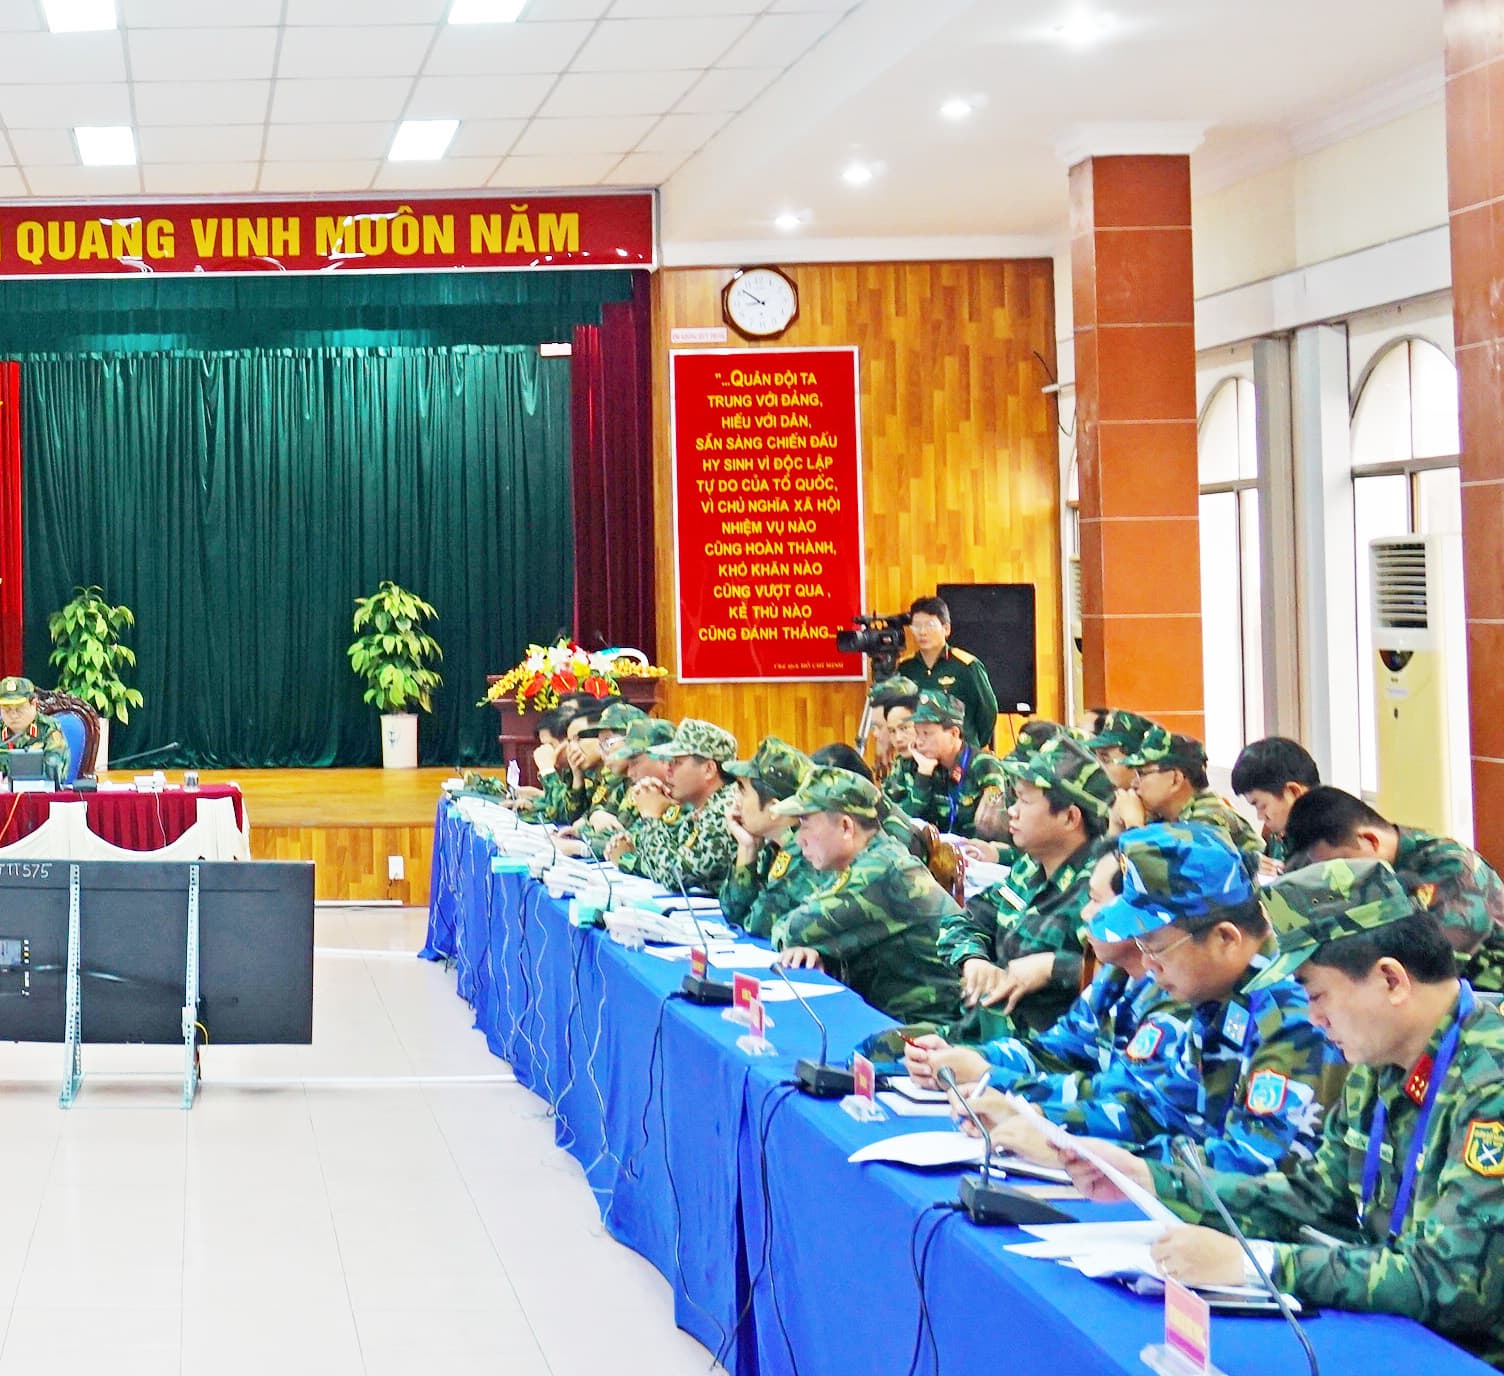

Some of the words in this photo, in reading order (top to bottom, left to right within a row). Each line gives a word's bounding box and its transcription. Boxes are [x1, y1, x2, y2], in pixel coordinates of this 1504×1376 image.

[16, 218, 175, 266] QUANG
[190, 217, 301, 259] VINH
[315, 205, 455, 257] MUÔN
[470, 204, 580, 254] NĂM
[773, 369, 798, 389] ĐỘI
[799, 371, 818, 386] TA
[706, 394, 753, 409] TRUNG
[755, 390, 779, 408] VỚI
[780, 389, 824, 408] ĐẢNG,
[721, 411, 752, 430] HIẾU
[754, 411, 777, 429] VỚI
[725, 434, 763, 451] SÀNG
[766, 431, 807, 450] CHIẾN
[809, 431, 838, 449] ĐẤU
[702, 458, 721, 472] HY
[723, 457, 754, 472] SINH
[756, 454, 770, 471] VÌ
[773, 454, 804, 472] ĐỘC
[806, 453, 834, 473] LẬP
[695, 478, 715, 496] TỰ
[717, 478, 739, 493] DO
[741, 474, 770, 493] CỦA
[771, 471, 792, 492] TỔ
[700, 497, 715, 514] VÌ
[717, 495, 746, 514] CHỦ
[747, 496, 790, 513] NGHĨA
[793, 496, 814, 513] XÃ
[816, 495, 841, 515] HỘI
[721, 517, 763, 537] NHIỆM
[765, 520, 785, 537] VỤ
[787, 517, 817, 534] NÀO
[704, 540, 743, 557] CŨNG
[744, 539, 784, 556] HOÀN
[786, 538, 837, 556] THÀNH,
[718, 561, 748, 577] KHÓ
[750, 560, 790, 577] KHĂN
[792, 559, 823, 576] NÀO
[713, 582, 752, 600] CŨNG
[754, 583, 792, 601] VƯỢT
[728, 600, 748, 620] KẺ
[751, 602, 779, 620] THÙ
[782, 602, 813, 619] NÀO
[697, 624, 737, 642] CŨNG
[740, 624, 778, 641] ĐÁNH
